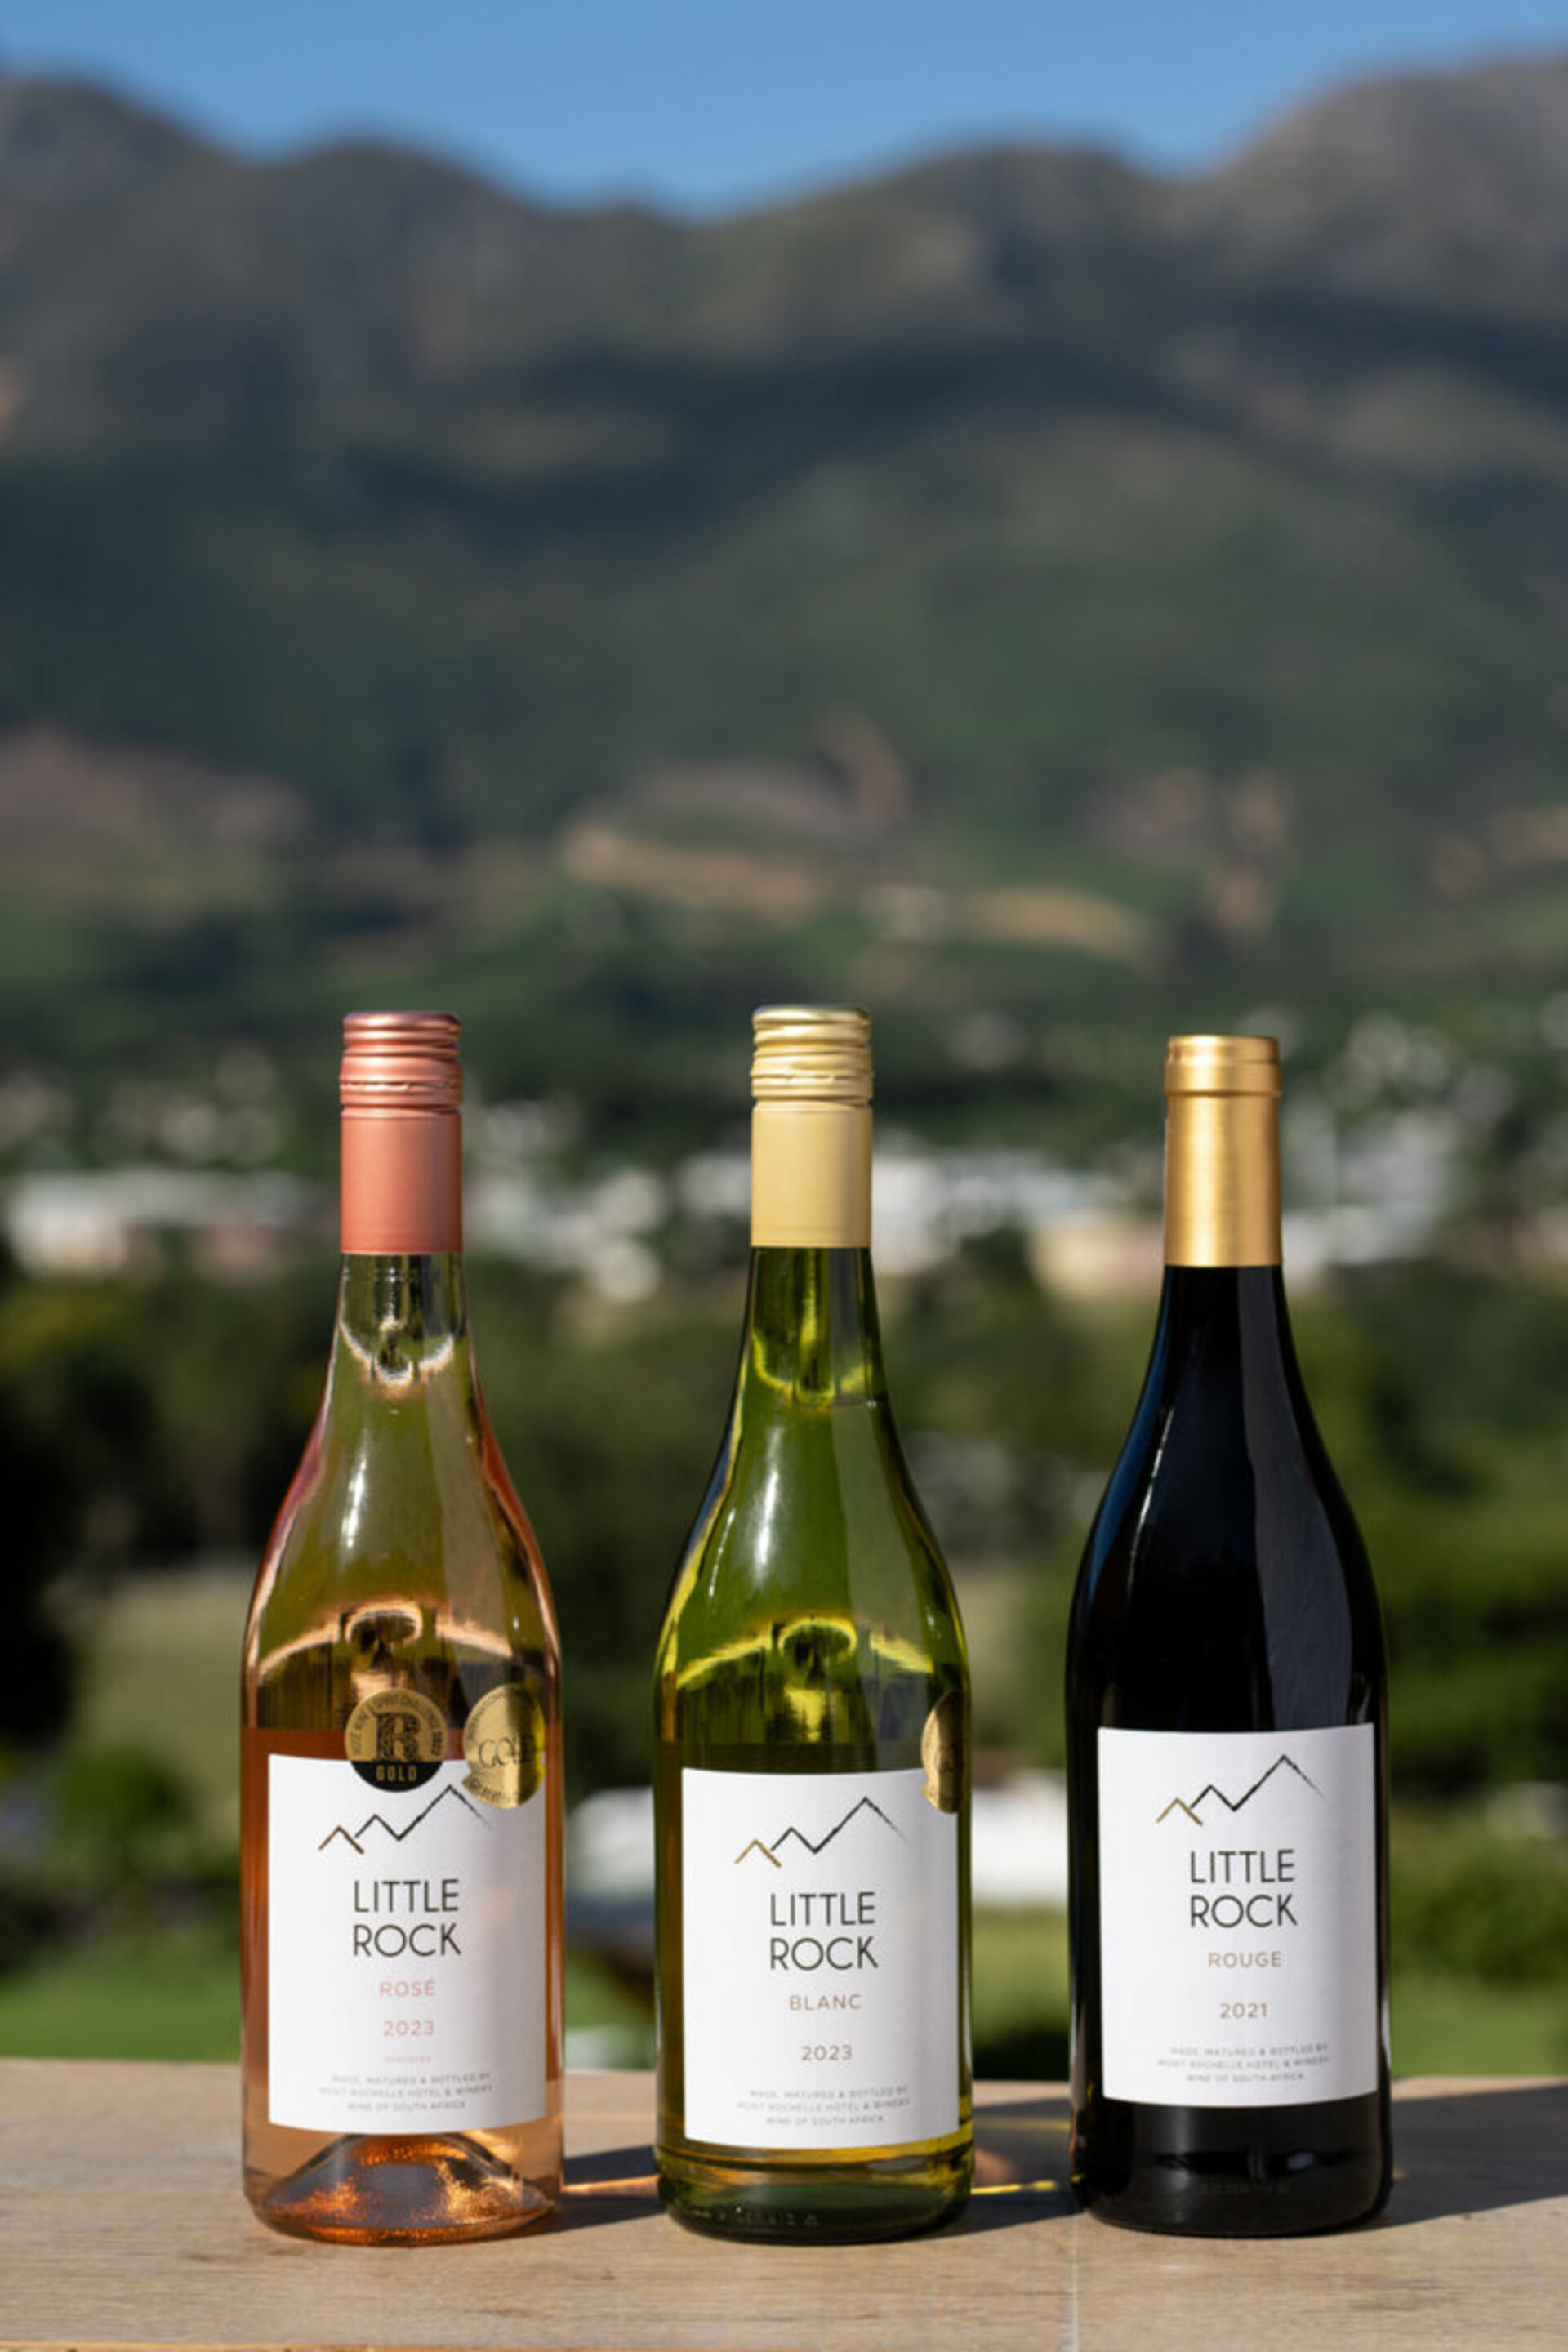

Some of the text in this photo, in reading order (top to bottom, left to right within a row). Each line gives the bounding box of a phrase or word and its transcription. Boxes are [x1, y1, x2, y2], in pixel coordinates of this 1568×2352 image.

[376, 1765, 417, 1782] GOLD
[1190, 1849, 1294, 1883] LITTLE
[354, 1879, 459, 1913] LITTLE
[769, 1891, 875, 1926] LITTLE
[1190, 1893, 1298, 1928] ROCK
[354, 1923, 461, 1958] ROCK
[769, 1936, 879, 1971] ROCK
[1207, 1951, 1282, 1968] ROUGE
[379, 1979, 436, 1998] ROSÉ
[789, 1994, 862, 2011] BLANC
[1219, 2003, 1268, 2019] 2021
[383, 2020, 435, 2037] 2023
[801, 2045, 853, 2061] 2023
